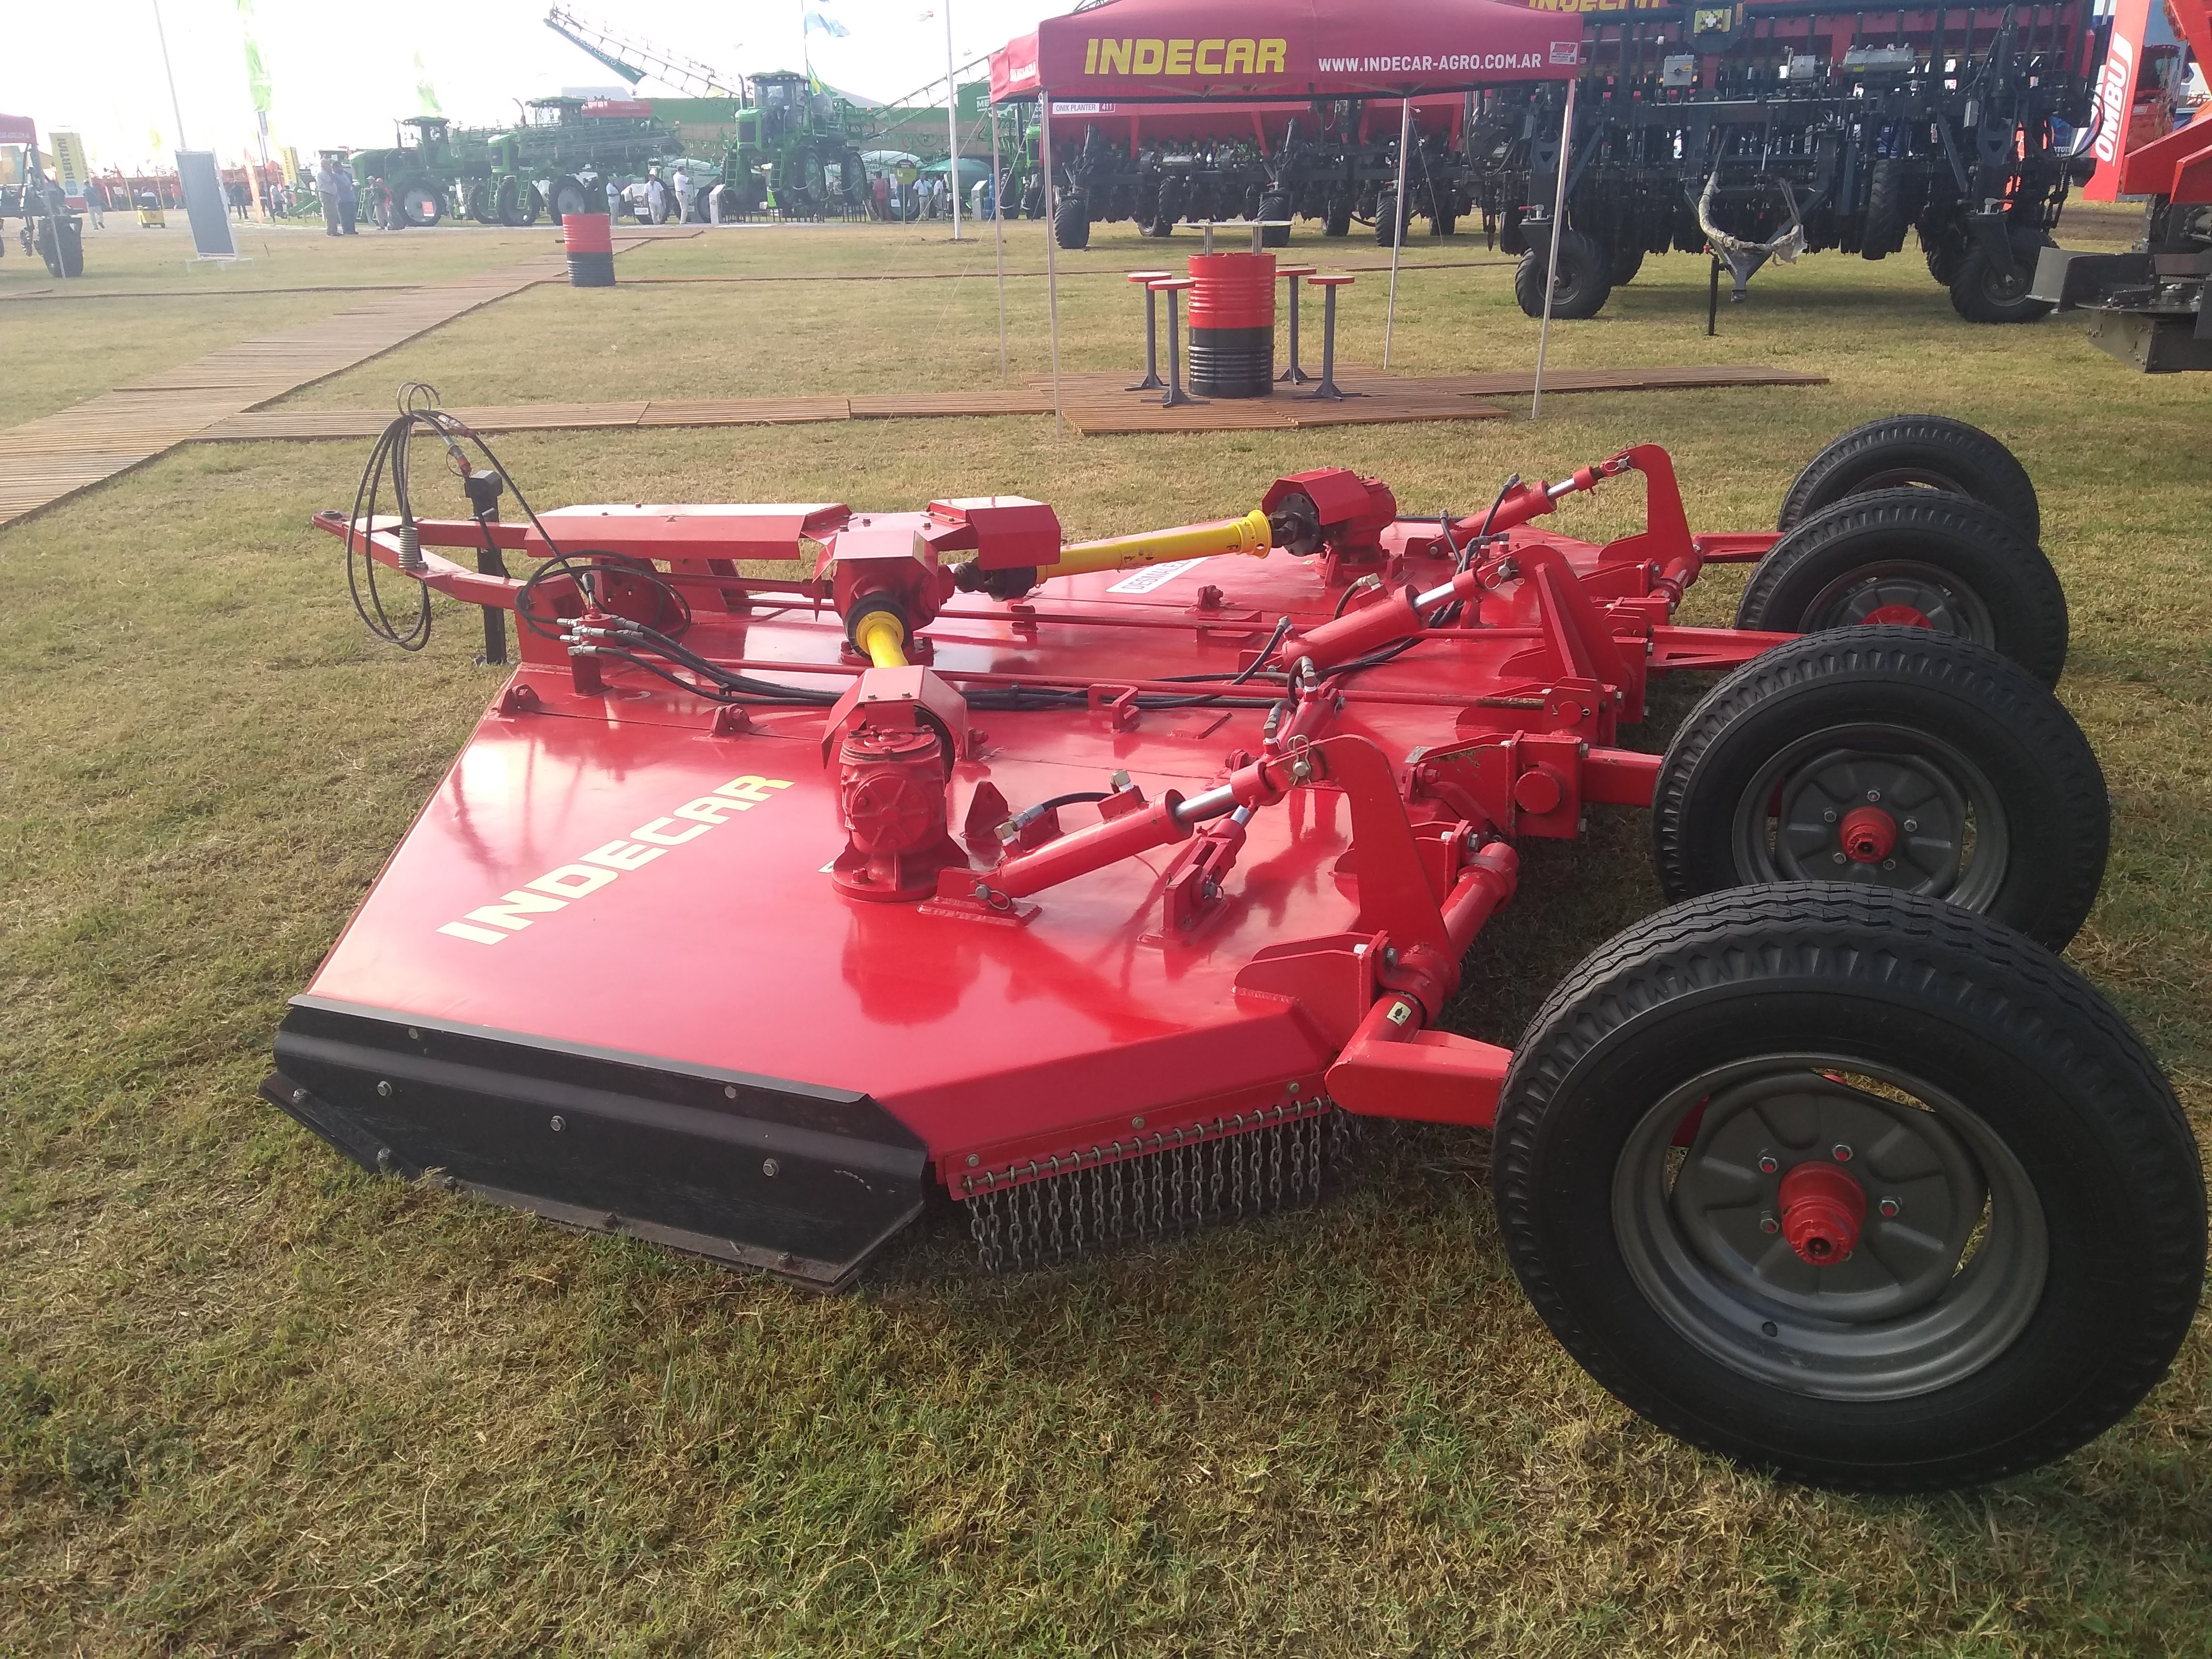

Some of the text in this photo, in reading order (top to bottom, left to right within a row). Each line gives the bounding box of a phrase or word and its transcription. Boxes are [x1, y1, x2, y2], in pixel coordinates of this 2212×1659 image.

[594, 48, 617, 66] COSTO
[1084, 38, 1287, 74] INDECAR
[1318, 53, 1541, 72] WWW.INDECAR-AGRO.COM.AR
[435, 774, 795, 946] INDECAR
